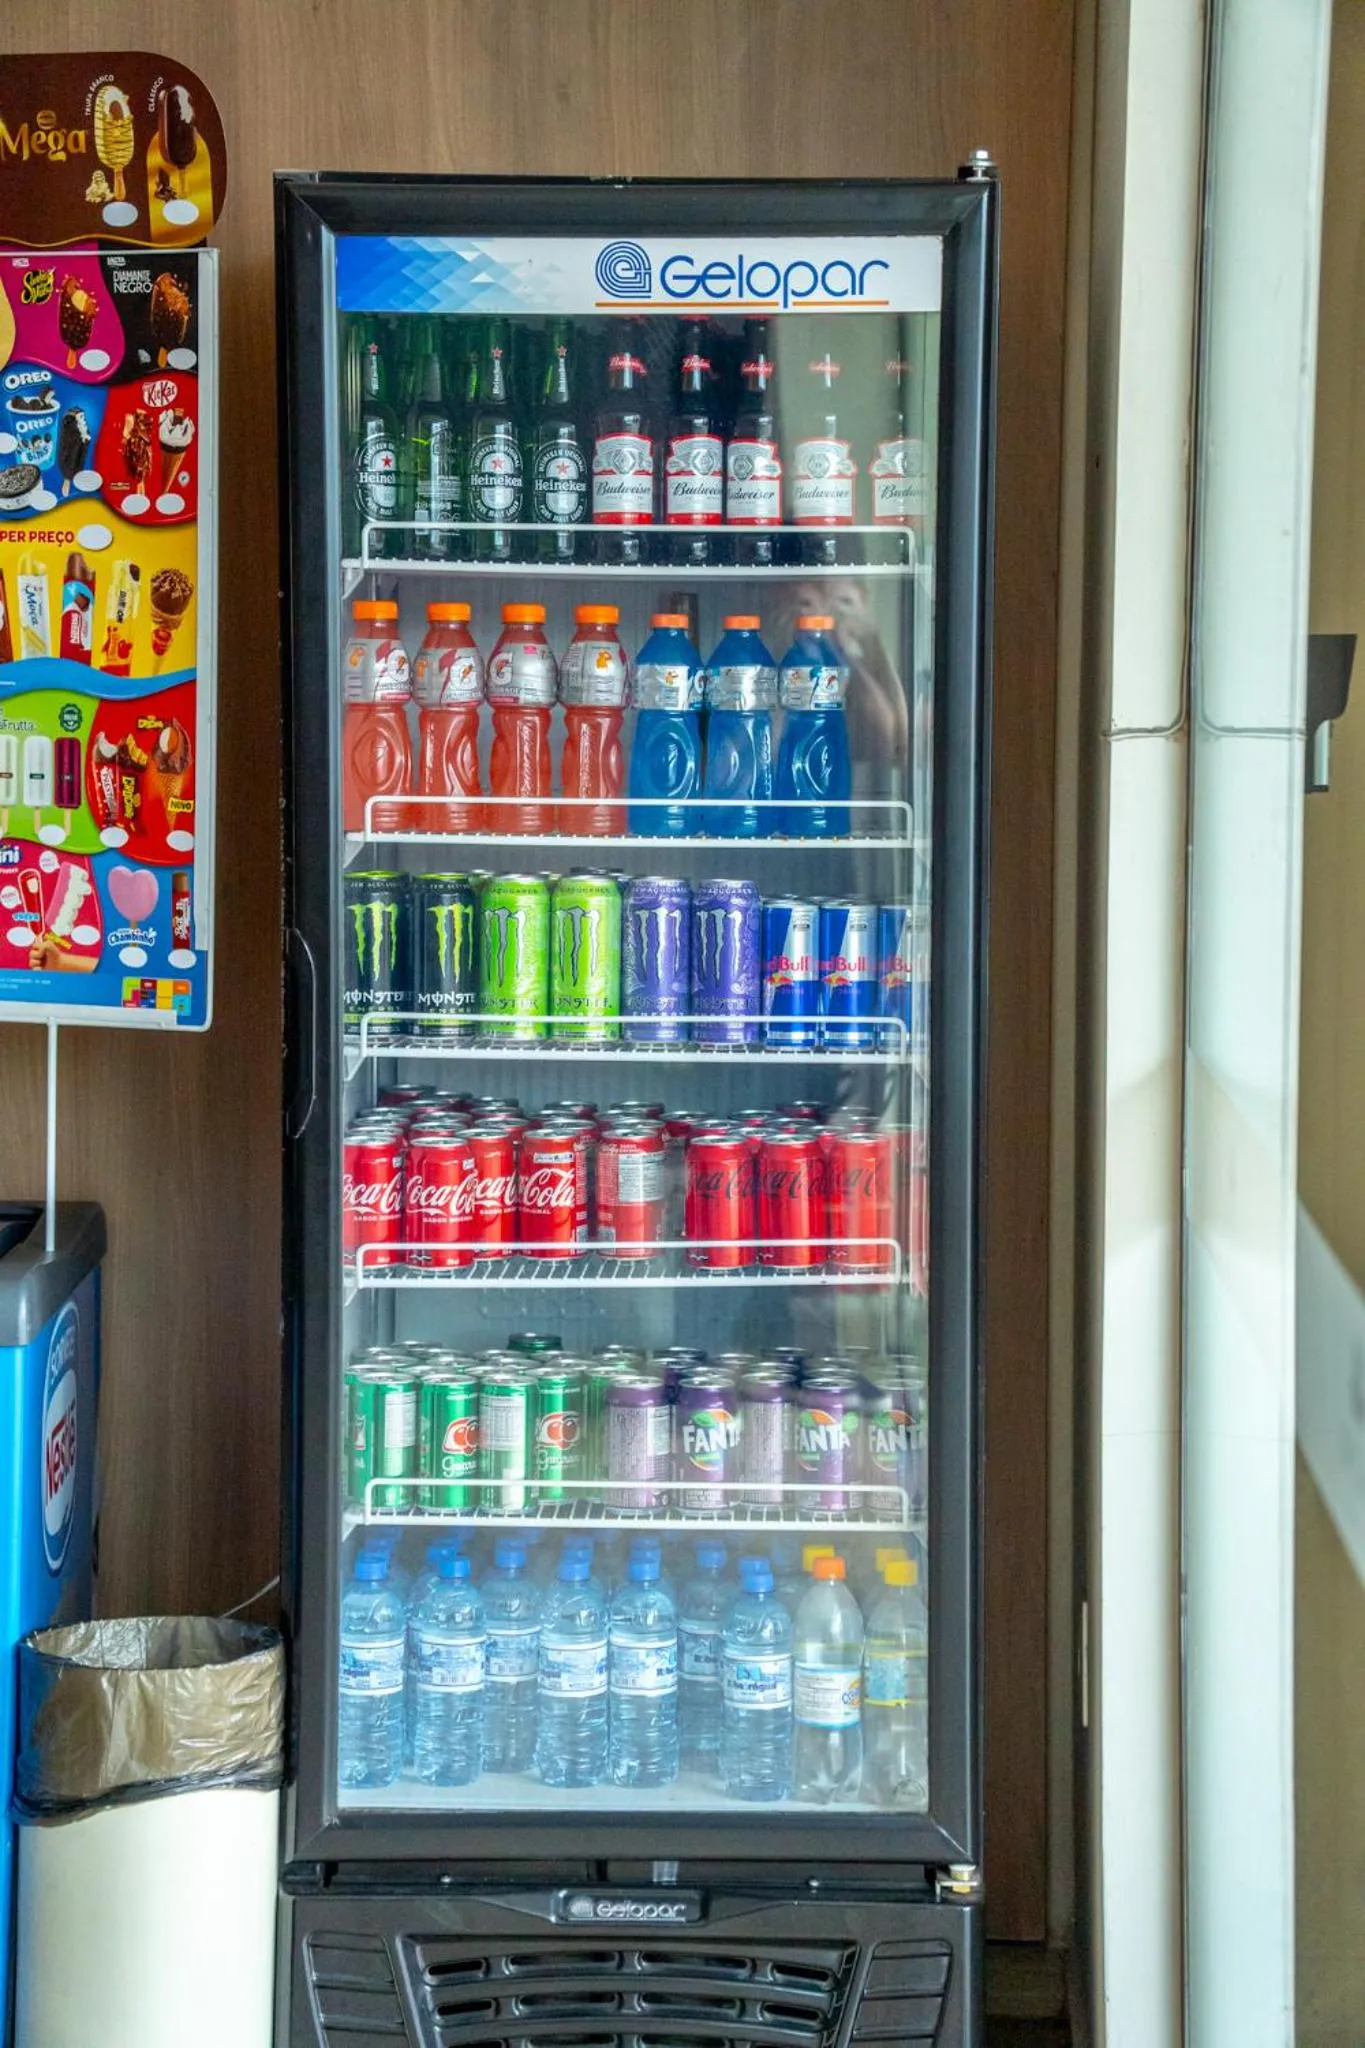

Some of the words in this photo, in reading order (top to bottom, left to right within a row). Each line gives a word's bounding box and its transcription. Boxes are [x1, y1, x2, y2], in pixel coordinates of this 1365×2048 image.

[0, 118, 88, 162] Mega
[113, 270, 150, 281] DIAMANTE
[660, 254, 890, 309] Gelopar
[113, 282, 153, 293] NEGRO
[5, 371, 51, 390] OREO
[16, 417, 53, 433] OREO
[0, 530, 25, 543] PER
[29, 530, 75, 547] PREÇO
[779, 956, 808, 972] Bull
[836, 956, 866, 972] Bull
[523, 1168, 575, 1207] Cola
[597, 1899, 686, 1918] Gelopar
